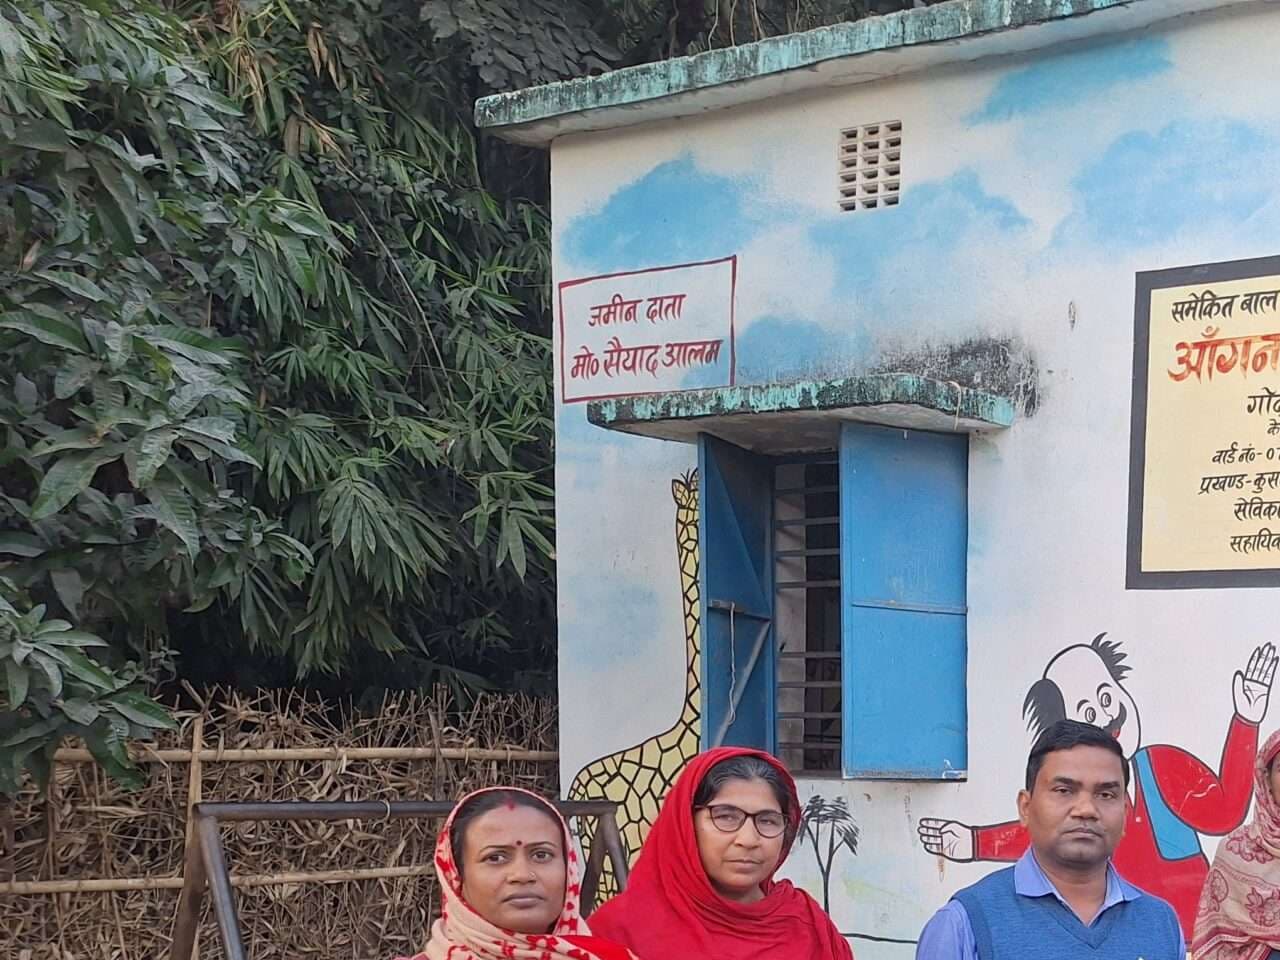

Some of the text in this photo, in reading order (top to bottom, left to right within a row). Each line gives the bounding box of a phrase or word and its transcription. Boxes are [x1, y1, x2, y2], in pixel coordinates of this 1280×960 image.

[588, 293, 687, 327] जमीन दाता
[1171, 289, 1240, 322] समेकित
[662, 339, 724, 369] आलम
[1211, 441, 1238, 464] वार्ड
